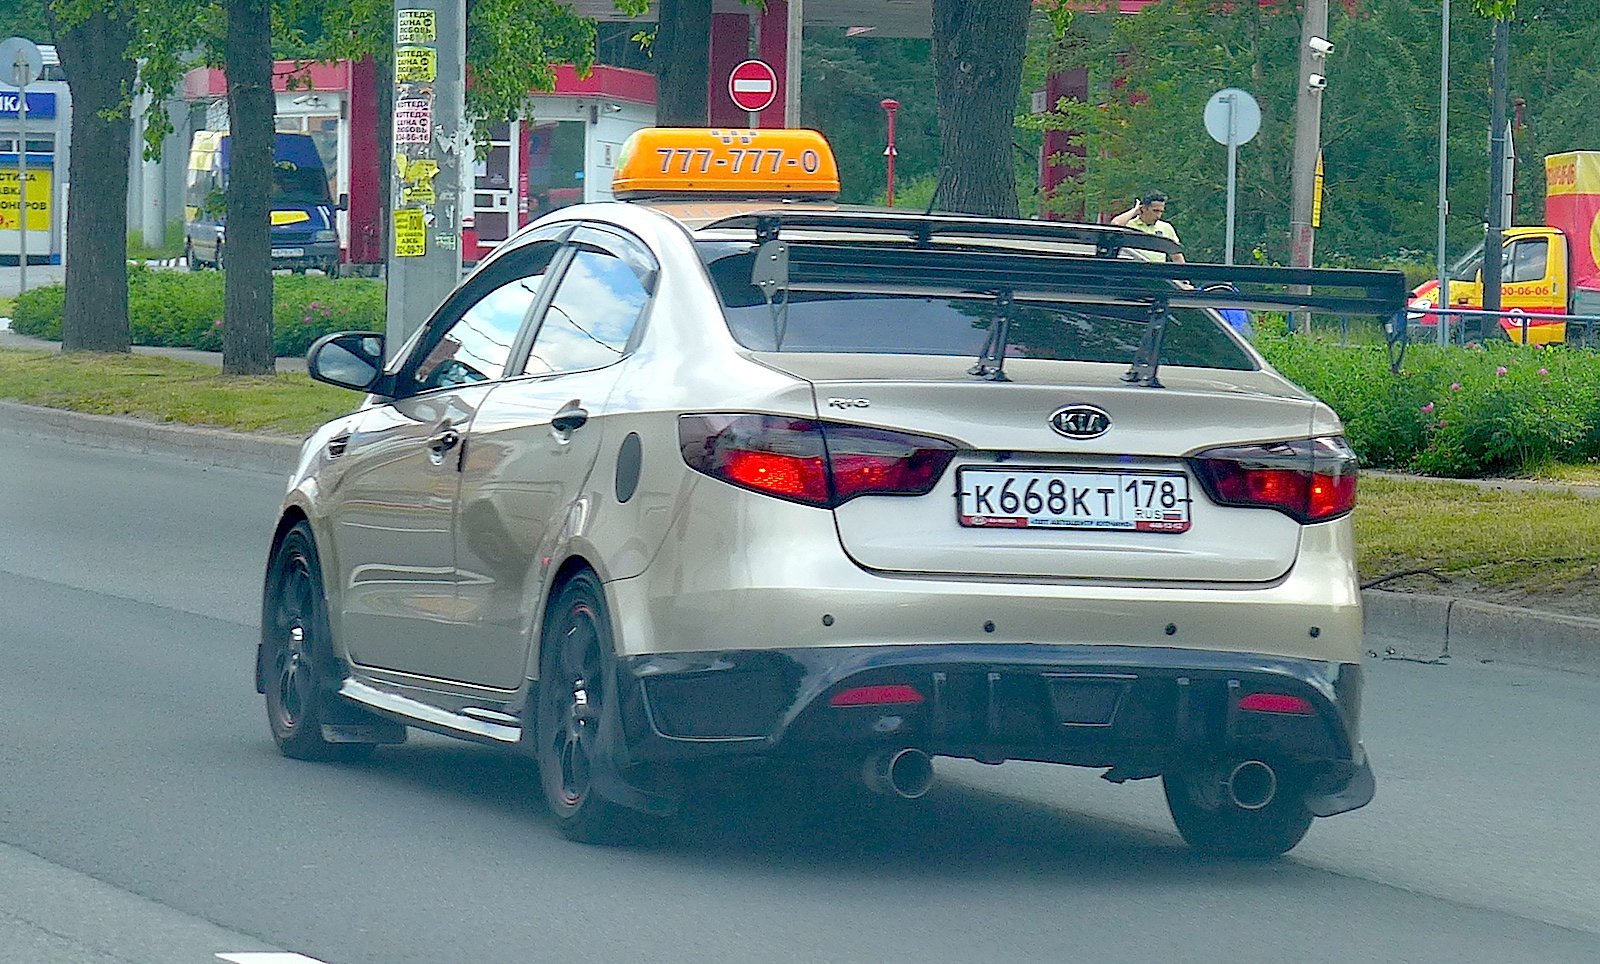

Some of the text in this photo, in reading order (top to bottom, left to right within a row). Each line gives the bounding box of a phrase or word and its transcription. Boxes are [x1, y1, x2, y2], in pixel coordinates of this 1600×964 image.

[656, 149, 821, 174] 777-777-0
[828, 397, 870, 409] RIO
[1060, 412, 1103, 432] KIA
[975, 478, 1116, 517] К668КТ
[1125, 480, 1176, 509] 178
[1135, 509, 1162, 520] RUS
